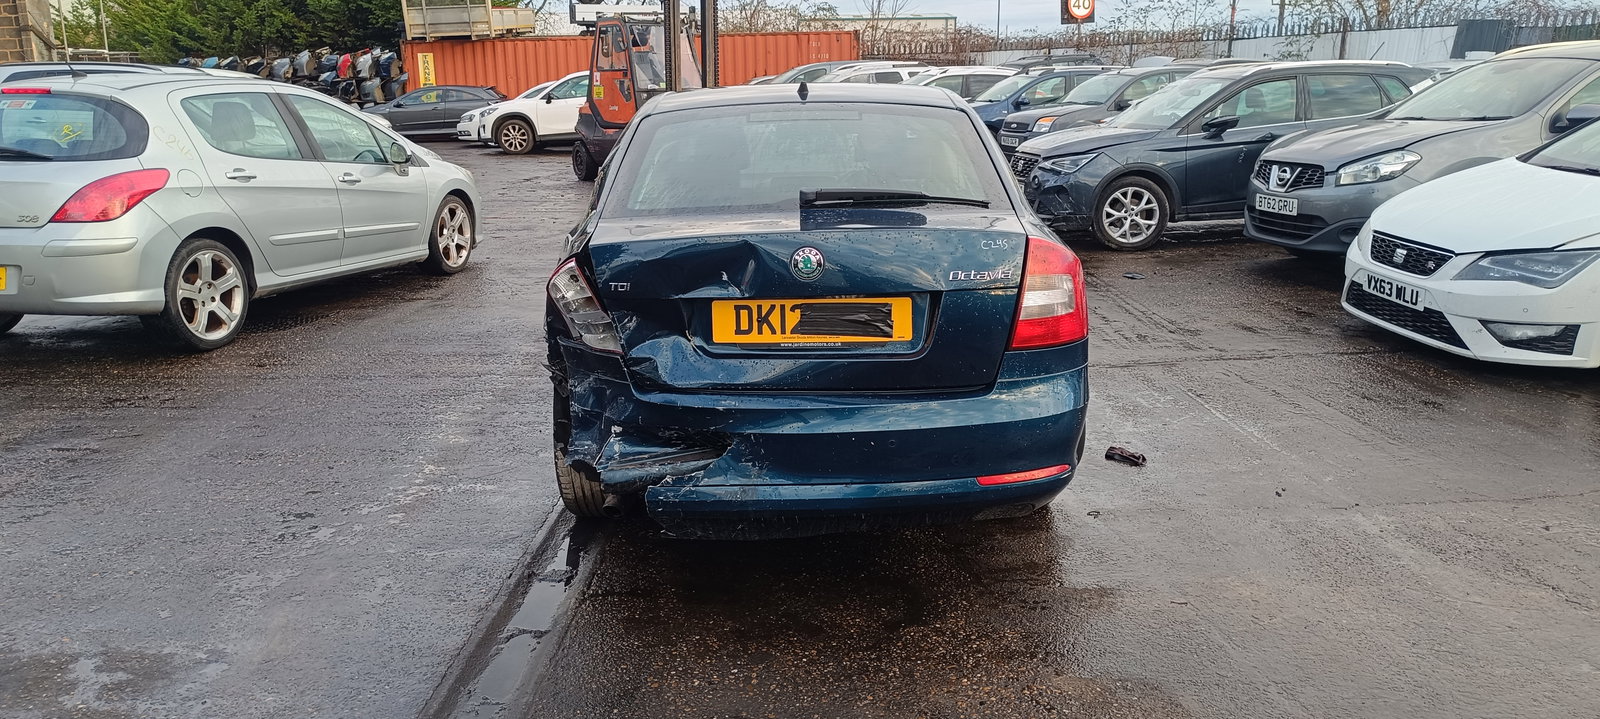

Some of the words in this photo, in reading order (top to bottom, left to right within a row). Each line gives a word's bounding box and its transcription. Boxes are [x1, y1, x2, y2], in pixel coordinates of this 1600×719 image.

[1072, 0, 1091, 9] 40
[422, 54, 431, 82] TRANS
[1258, 196, 1276, 210] BT62
[1277, 199, 1294, 213] GRU
[17, 215, 39, 223] 308
[949, 269, 1012, 281] Octavia
[609, 282, 631, 291] TDI
[1367, 273, 1394, 298] VX63
[1395, 283, 1419, 306] WLU
